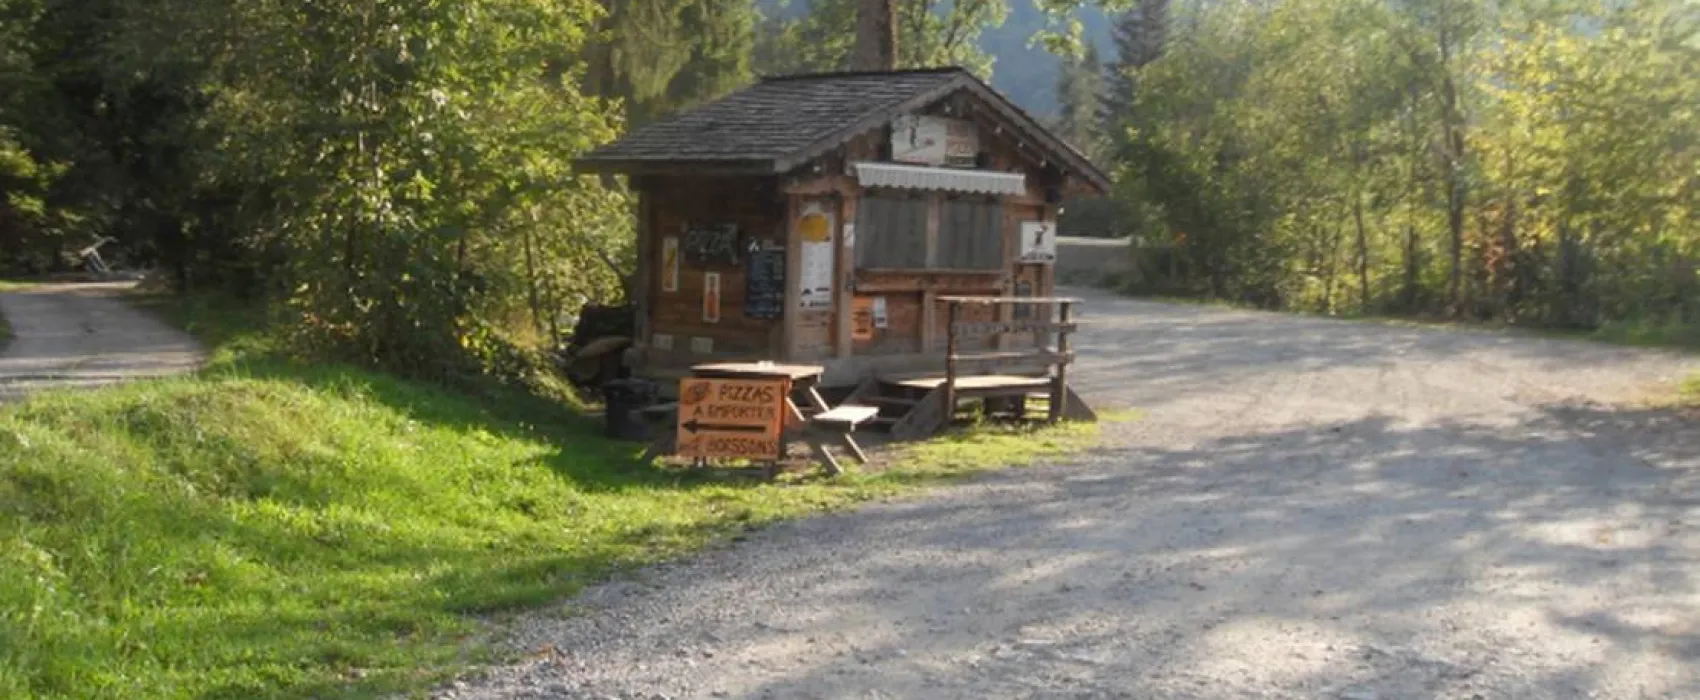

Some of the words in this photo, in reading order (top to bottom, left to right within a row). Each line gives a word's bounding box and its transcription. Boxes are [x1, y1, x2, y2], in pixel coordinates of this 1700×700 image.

[719, 384, 775, 404] PIZZAS
[692, 404, 704, 417] A
[708, 403, 775, 420] EMPORTER
